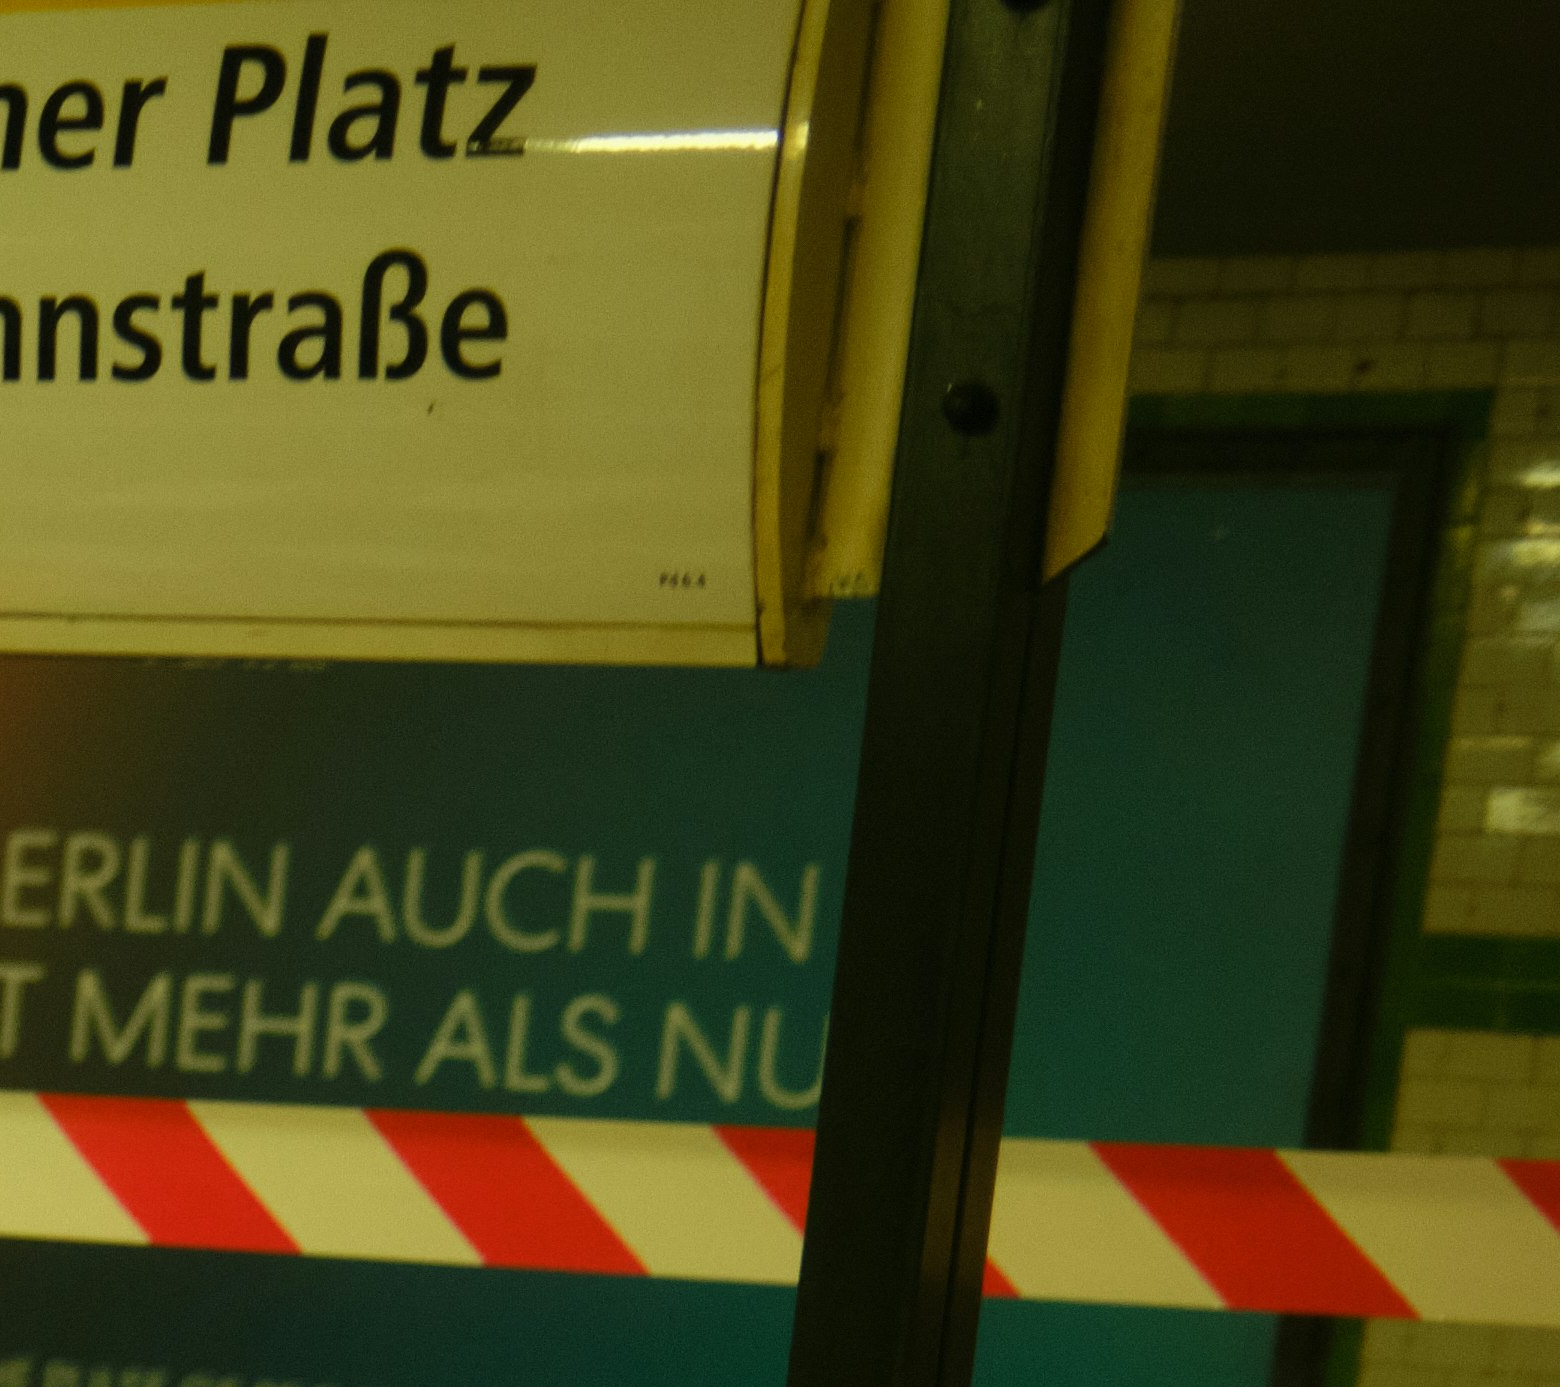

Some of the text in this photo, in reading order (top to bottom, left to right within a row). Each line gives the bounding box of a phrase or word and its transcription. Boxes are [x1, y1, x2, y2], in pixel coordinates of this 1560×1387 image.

[205, 31, 540, 166] Platz
[319, 843, 656, 957] AUCH
[692, 855, 824, 966] IN
[70, 968, 390, 1083] MEHR
[417, 992, 624, 1100] ALS
[656, 1003, 829, 1112] NU
